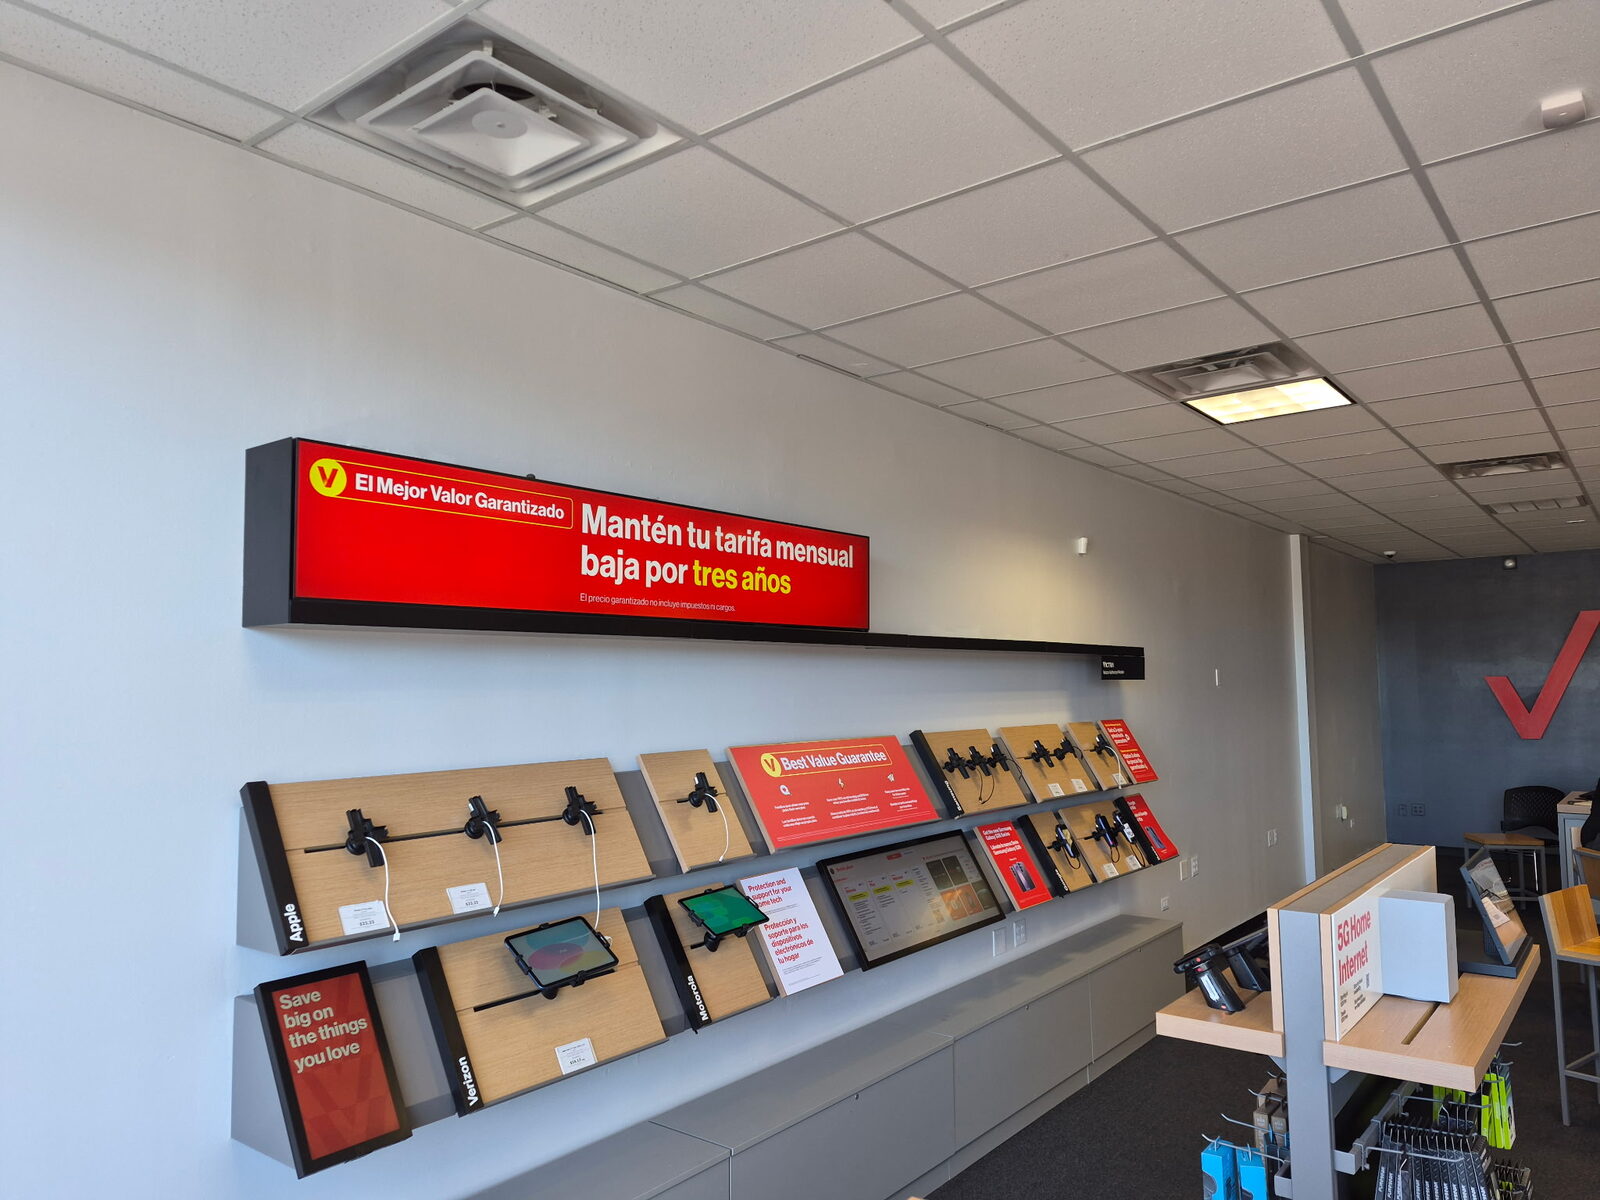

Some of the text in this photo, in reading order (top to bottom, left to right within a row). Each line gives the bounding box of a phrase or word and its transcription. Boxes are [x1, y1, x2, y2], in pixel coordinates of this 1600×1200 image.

[355, 472, 374, 492] El
[376, 476, 428, 501] Mejor
[430, 484, 473, 506] Valor
[474, 492, 565, 520] Garantizado
[581, 502, 854, 568] Mantén tu tarifa mensual
[580, 545, 792, 594] baja por tres años
[579, 592, 588, 602] El
[588, 595, 610, 605] precio
[611, 596, 650, 607] garantizado
[650, 599, 658, 607] no
[658, 598, 680, 609] incluye
[680, 601, 710, 611] impuestos
[780, 756, 808, 771] Best
[810, 752, 838, 767] Value
[837, 749, 887, 765] Guarantee
[748, 878, 786, 892] Protection and
[752, 891, 773, 900] support
[780, 886, 792, 895] your
[770, 895, 783, 904] tech
[283, 903, 304, 942] Apple
[764, 918, 793, 931] Protección
[768, 929, 789, 940] soporte
[789, 925, 800, 935] para
[1337, 910, 1371, 952] 5G Home
[772, 934, 803, 947] dispositivos
[785, 953, 800, 962] hogar
[1339, 940, 1369, 986] Internet
[278, 990, 322, 1010] Save
[687, 974, 709, 1021] Motorola
[283, 1006, 335, 1029] big on
[288, 1017, 369, 1049] the things
[293, 1041, 361, 1074] you love
[458, 1055, 479, 1107] Verizon
